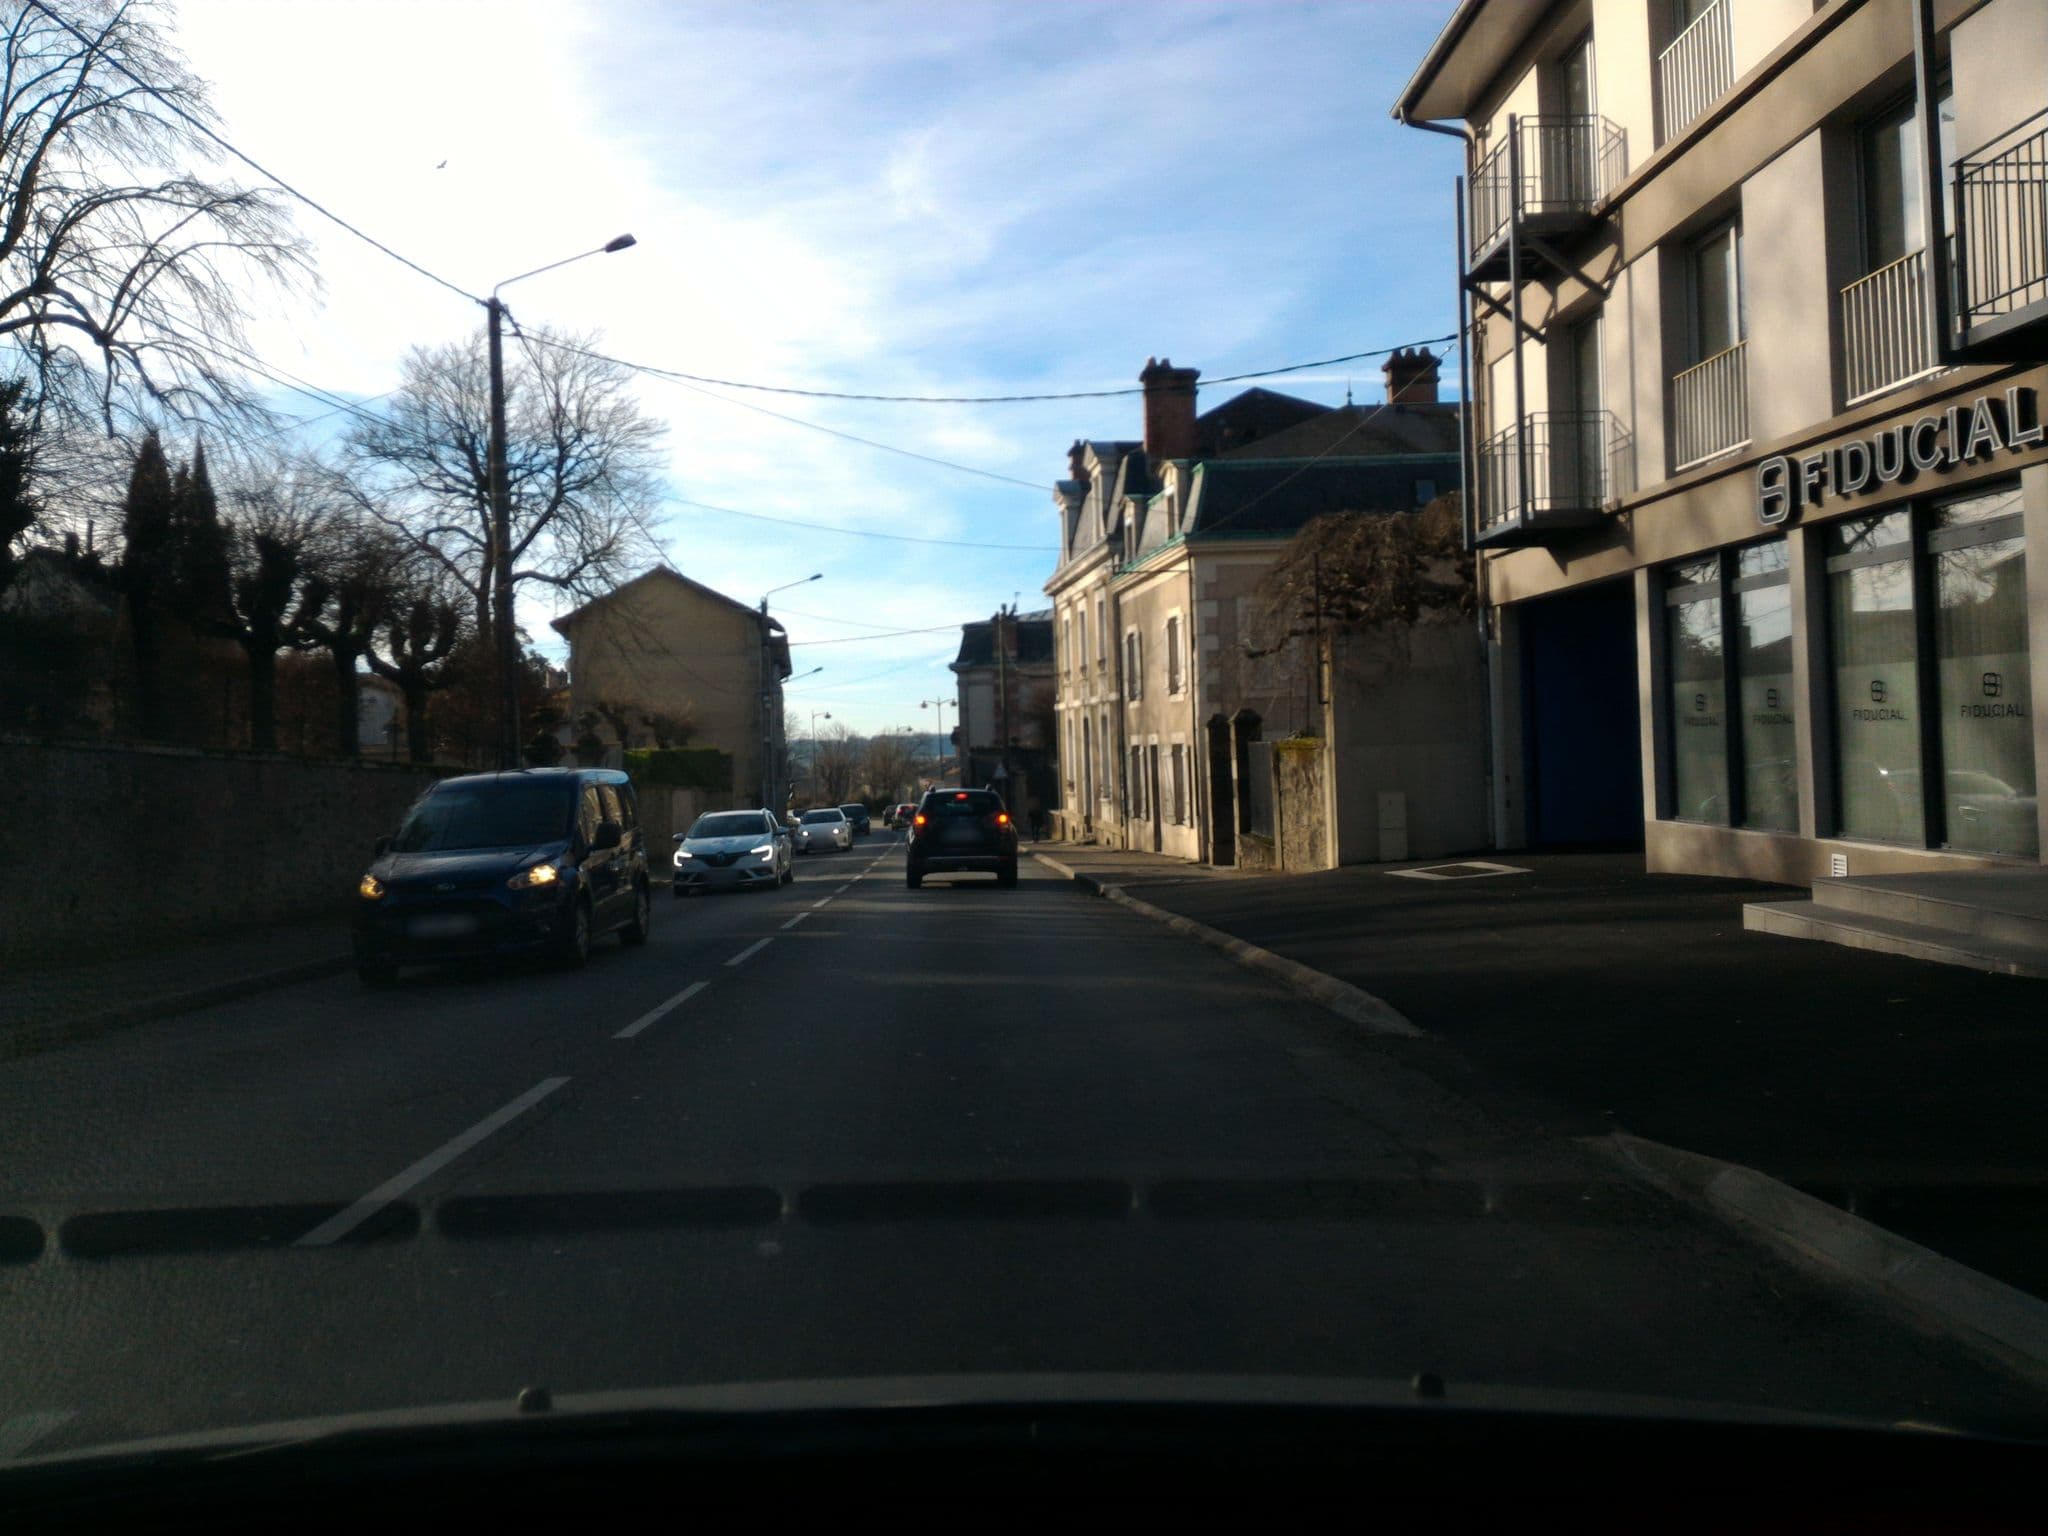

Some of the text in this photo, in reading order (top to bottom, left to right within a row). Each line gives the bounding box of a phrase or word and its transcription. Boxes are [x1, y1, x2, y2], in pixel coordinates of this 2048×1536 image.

[1800, 386, 2043, 505] FIDUCIAL
[1853, 708, 1906, 721] FIDUCIAL
[1961, 703, 2024, 720] FIDUCIAL
